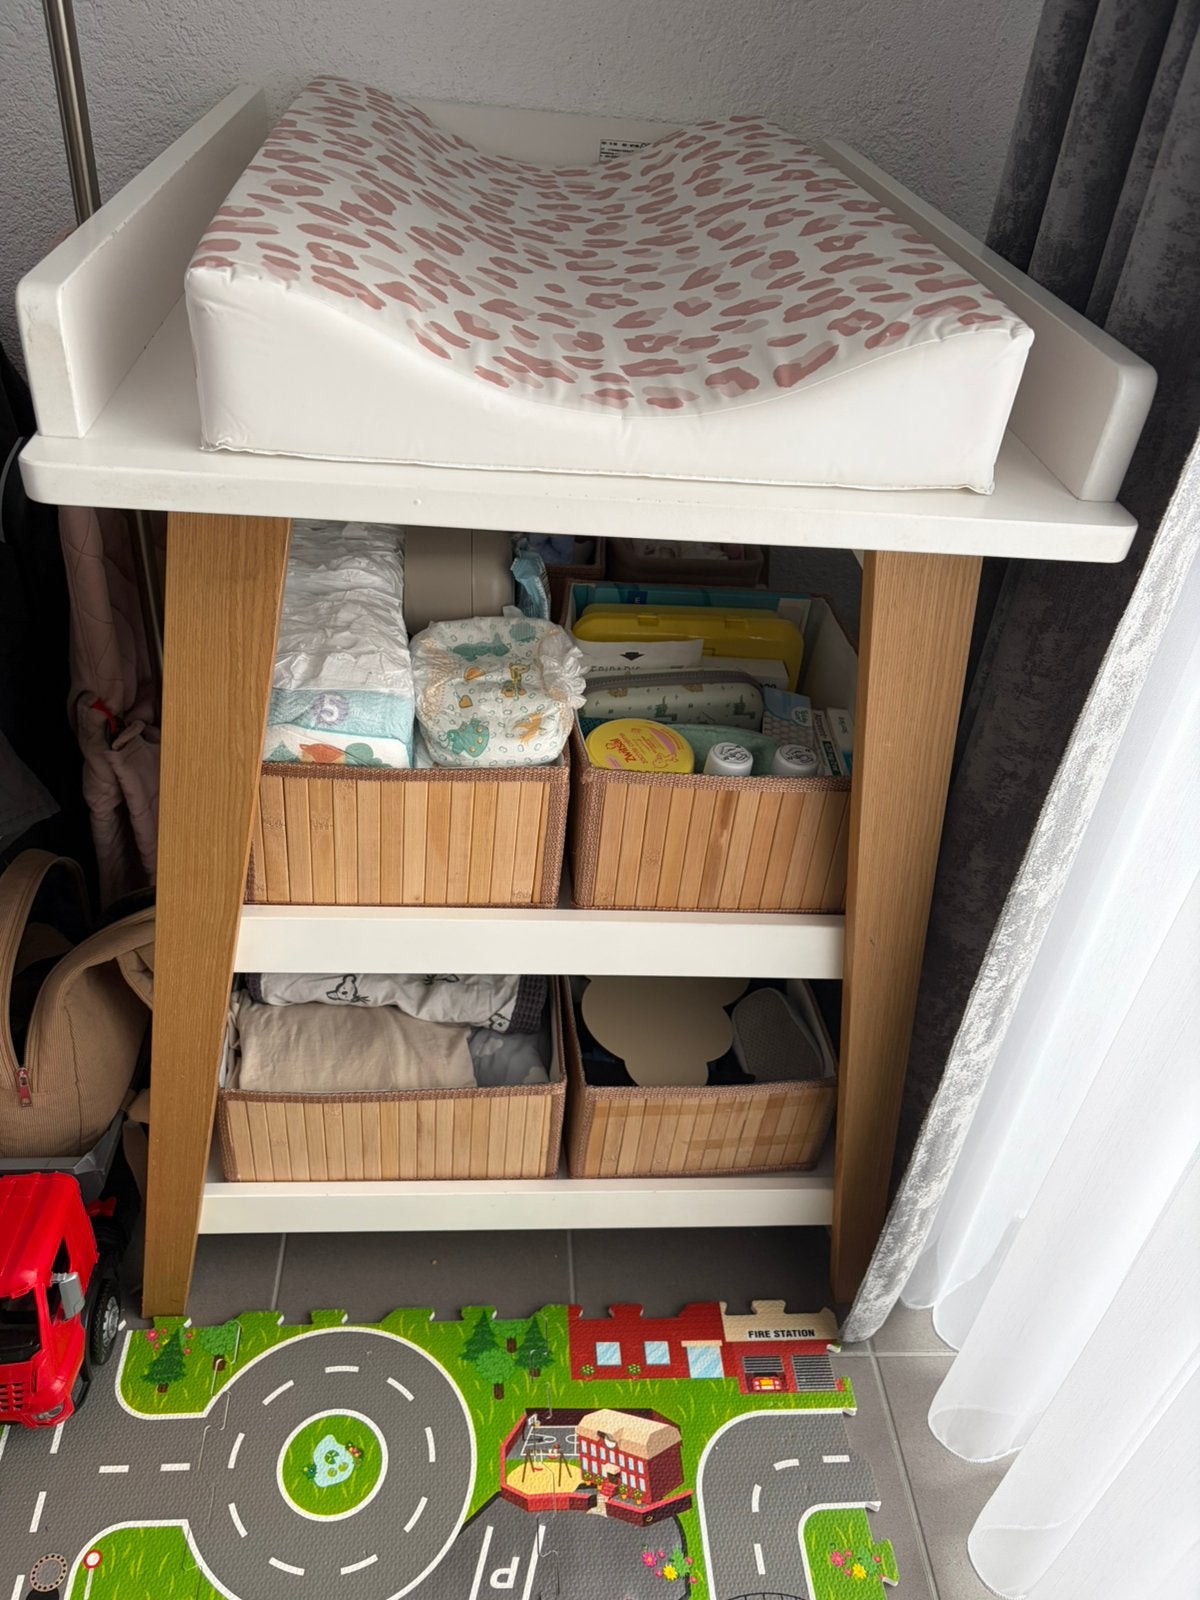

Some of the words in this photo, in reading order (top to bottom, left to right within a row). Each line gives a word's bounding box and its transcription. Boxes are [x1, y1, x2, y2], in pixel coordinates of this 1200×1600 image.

[748, 1330, 771, 1338] FIRE
[774, 1329, 815, 1338] STATION
[489, 1556, 520, 1589] P
